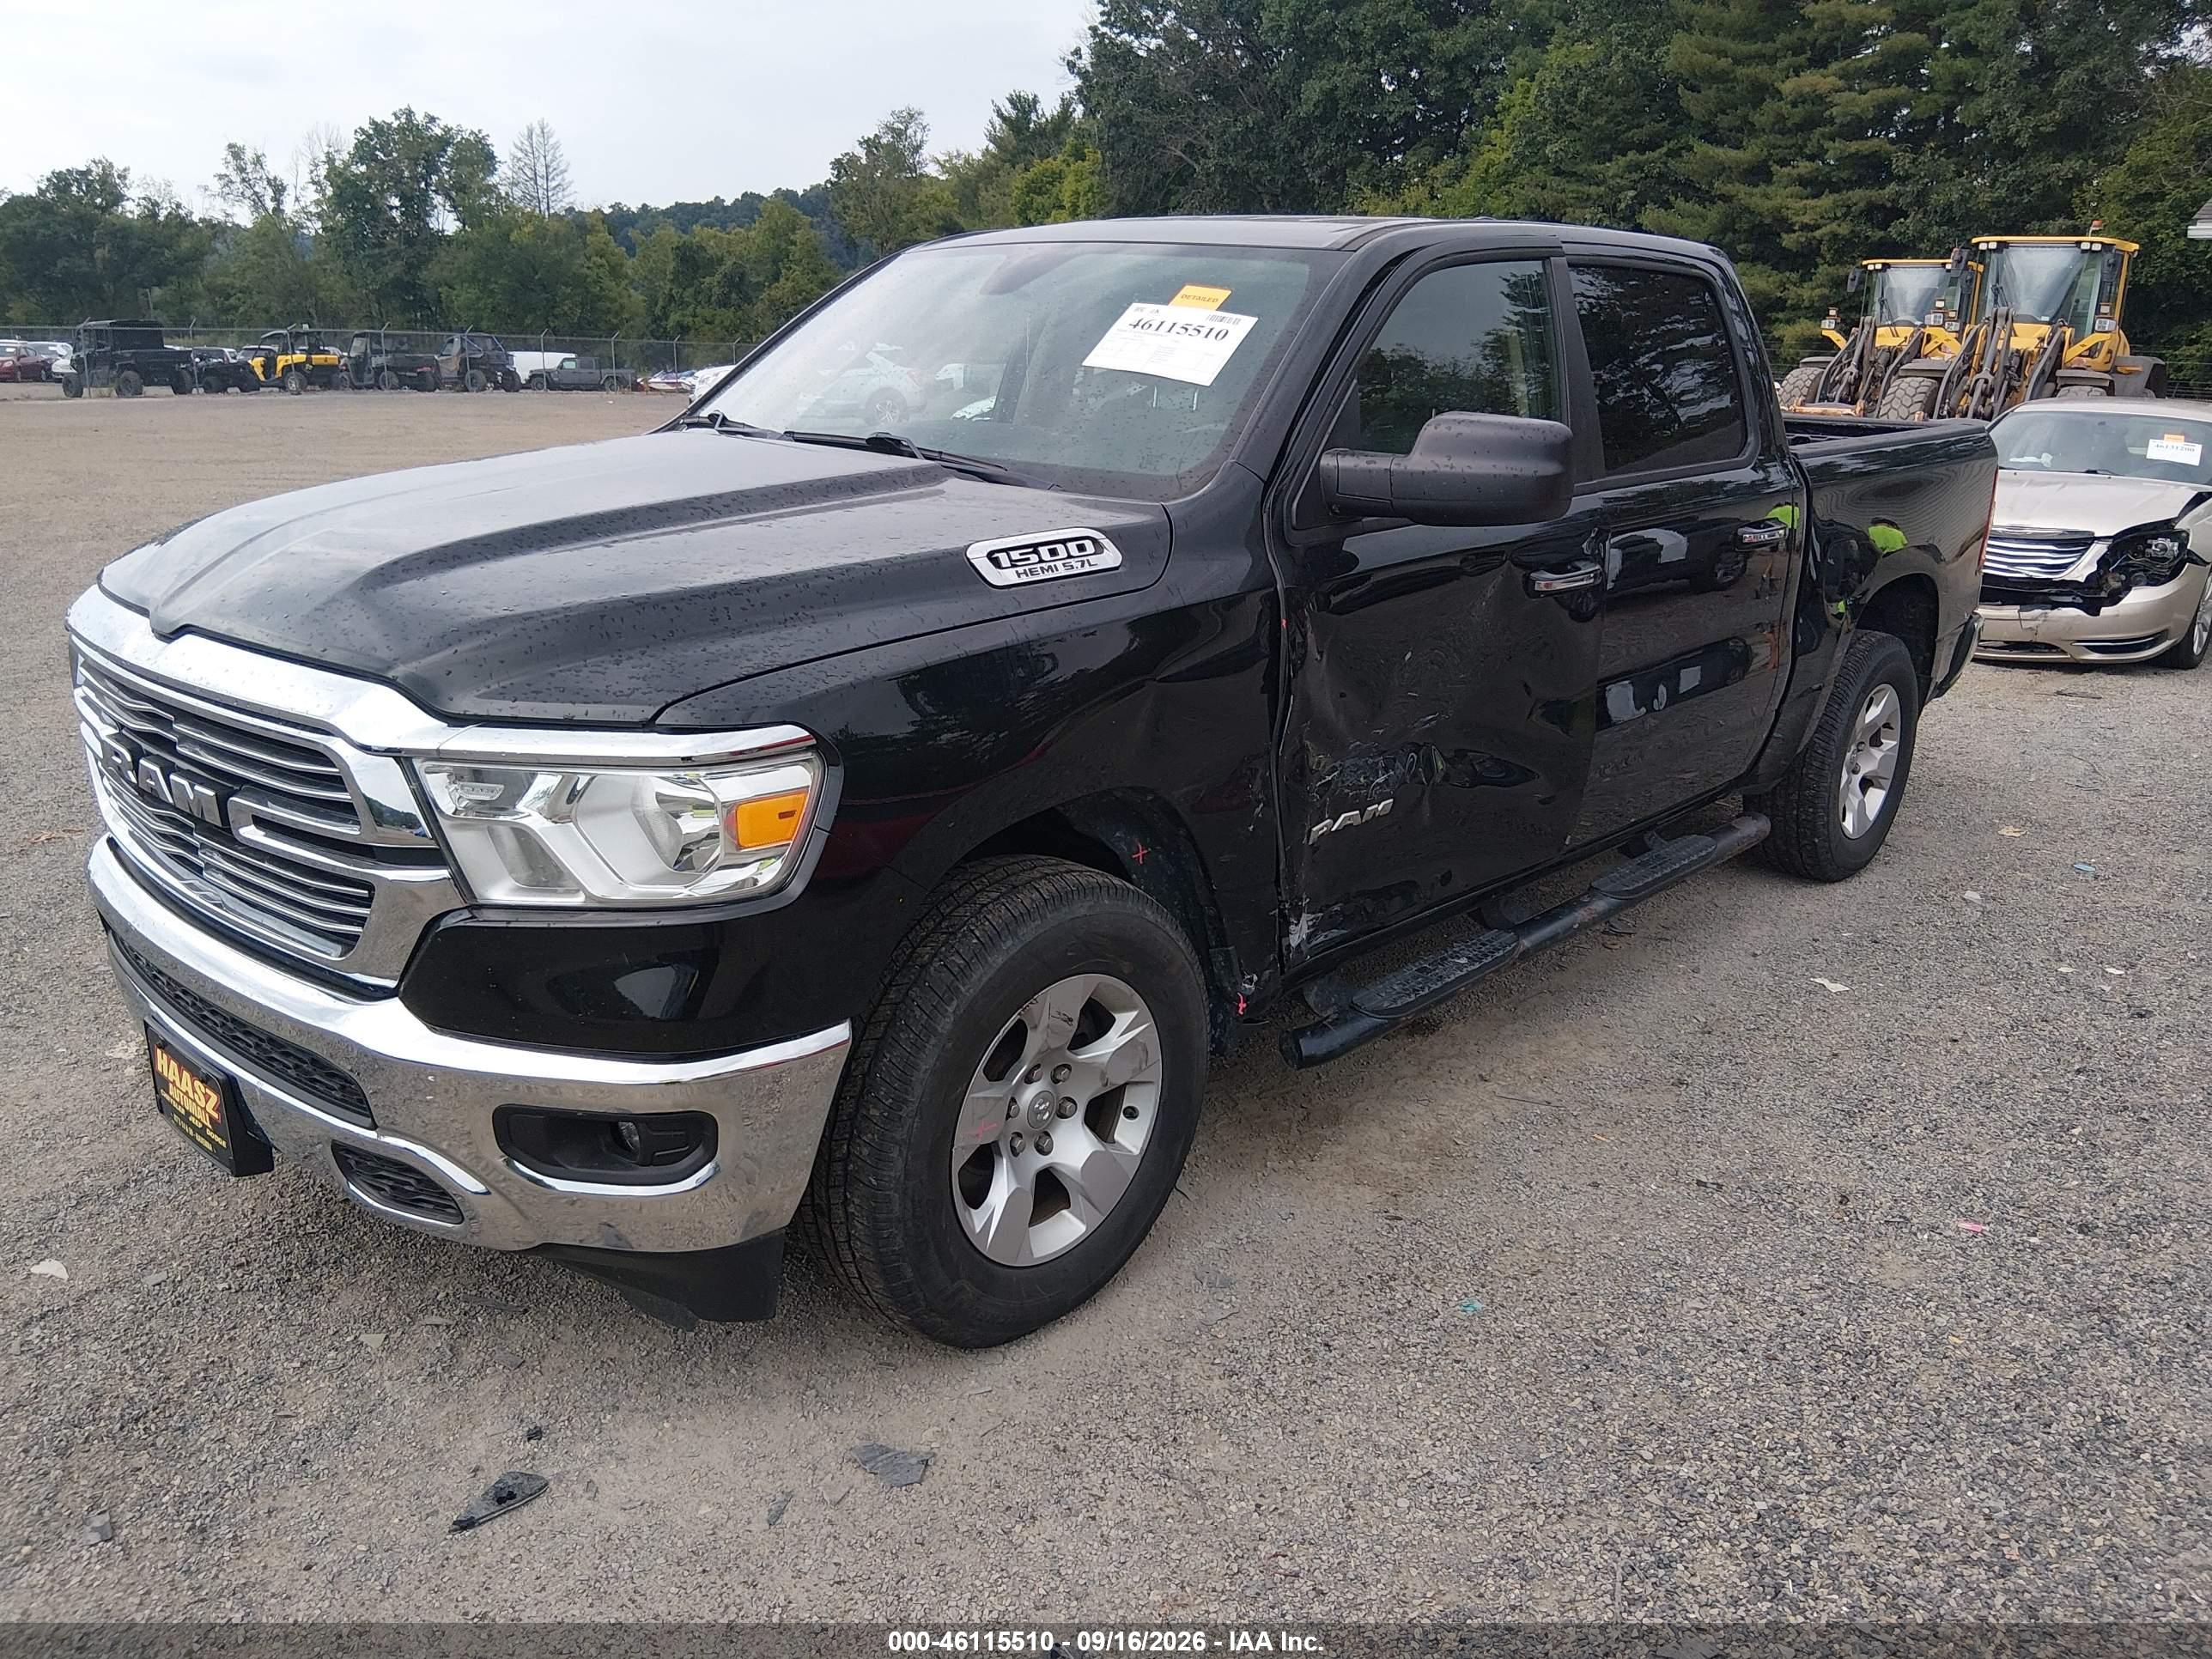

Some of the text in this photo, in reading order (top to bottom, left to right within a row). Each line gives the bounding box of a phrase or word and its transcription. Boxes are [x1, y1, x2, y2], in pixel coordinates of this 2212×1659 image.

[1181, 293, 1219, 304] DETAILED
[1128, 317, 1230, 342] 46115510
[991, 538, 1096, 568] 1500
[1015, 558, 1098, 579] HEMI 5.7L
[101, 734, 223, 828] RAM
[1308, 798, 1395, 846] RAM
[155, 1045, 221, 1122] HAASZ
[168, 1083, 213, 1129] AUTOMALL
[188, 1115, 204, 1129] JEEP
[206, 1127, 228, 1149] DODGE
